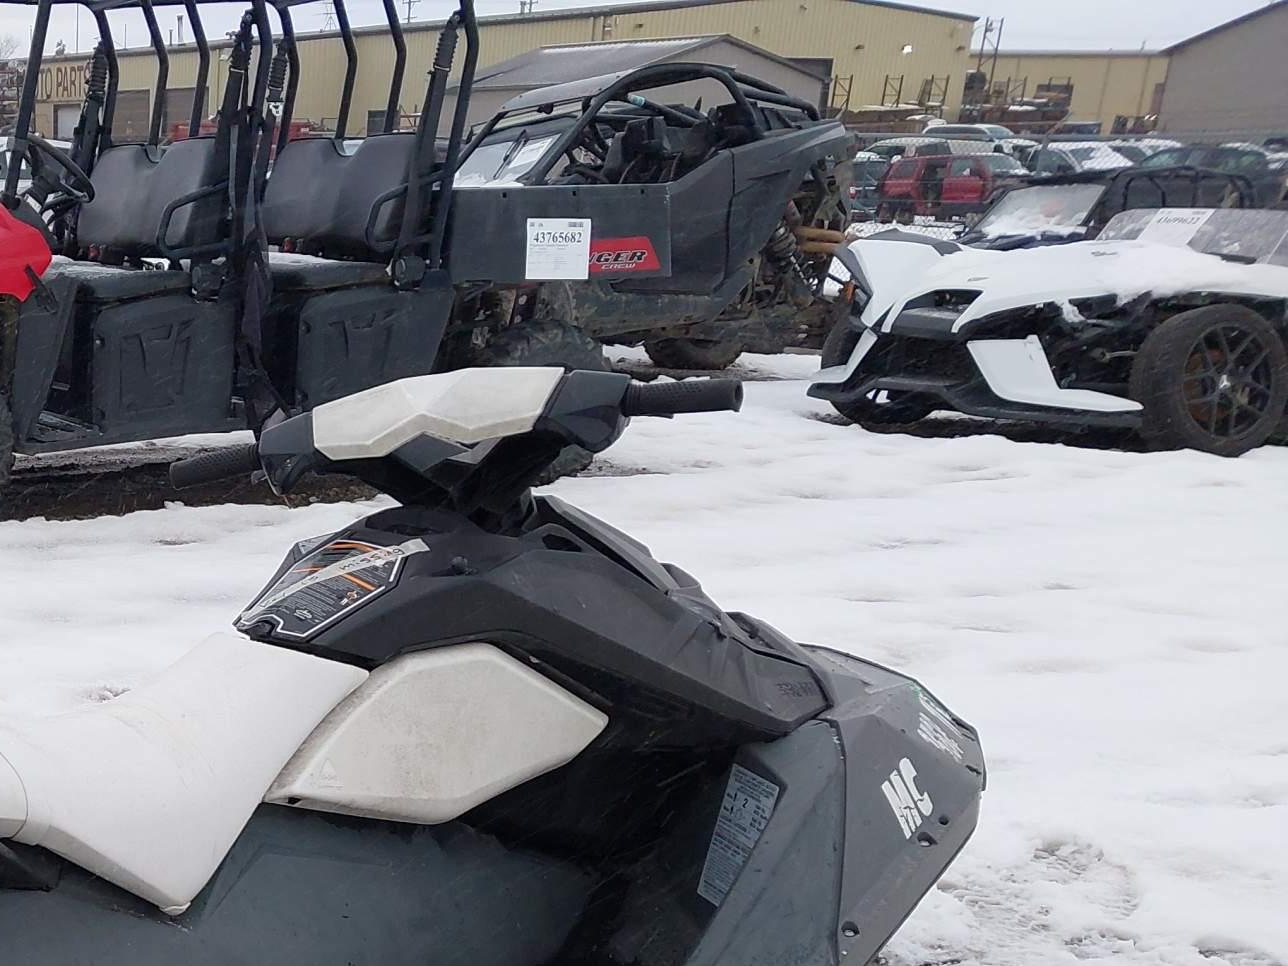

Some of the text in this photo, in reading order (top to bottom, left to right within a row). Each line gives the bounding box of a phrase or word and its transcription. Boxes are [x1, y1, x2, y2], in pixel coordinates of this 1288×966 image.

[533, 231, 582, 244] 43765682
[589, 250, 647, 264] GER
[881, 757, 933, 840] MC
